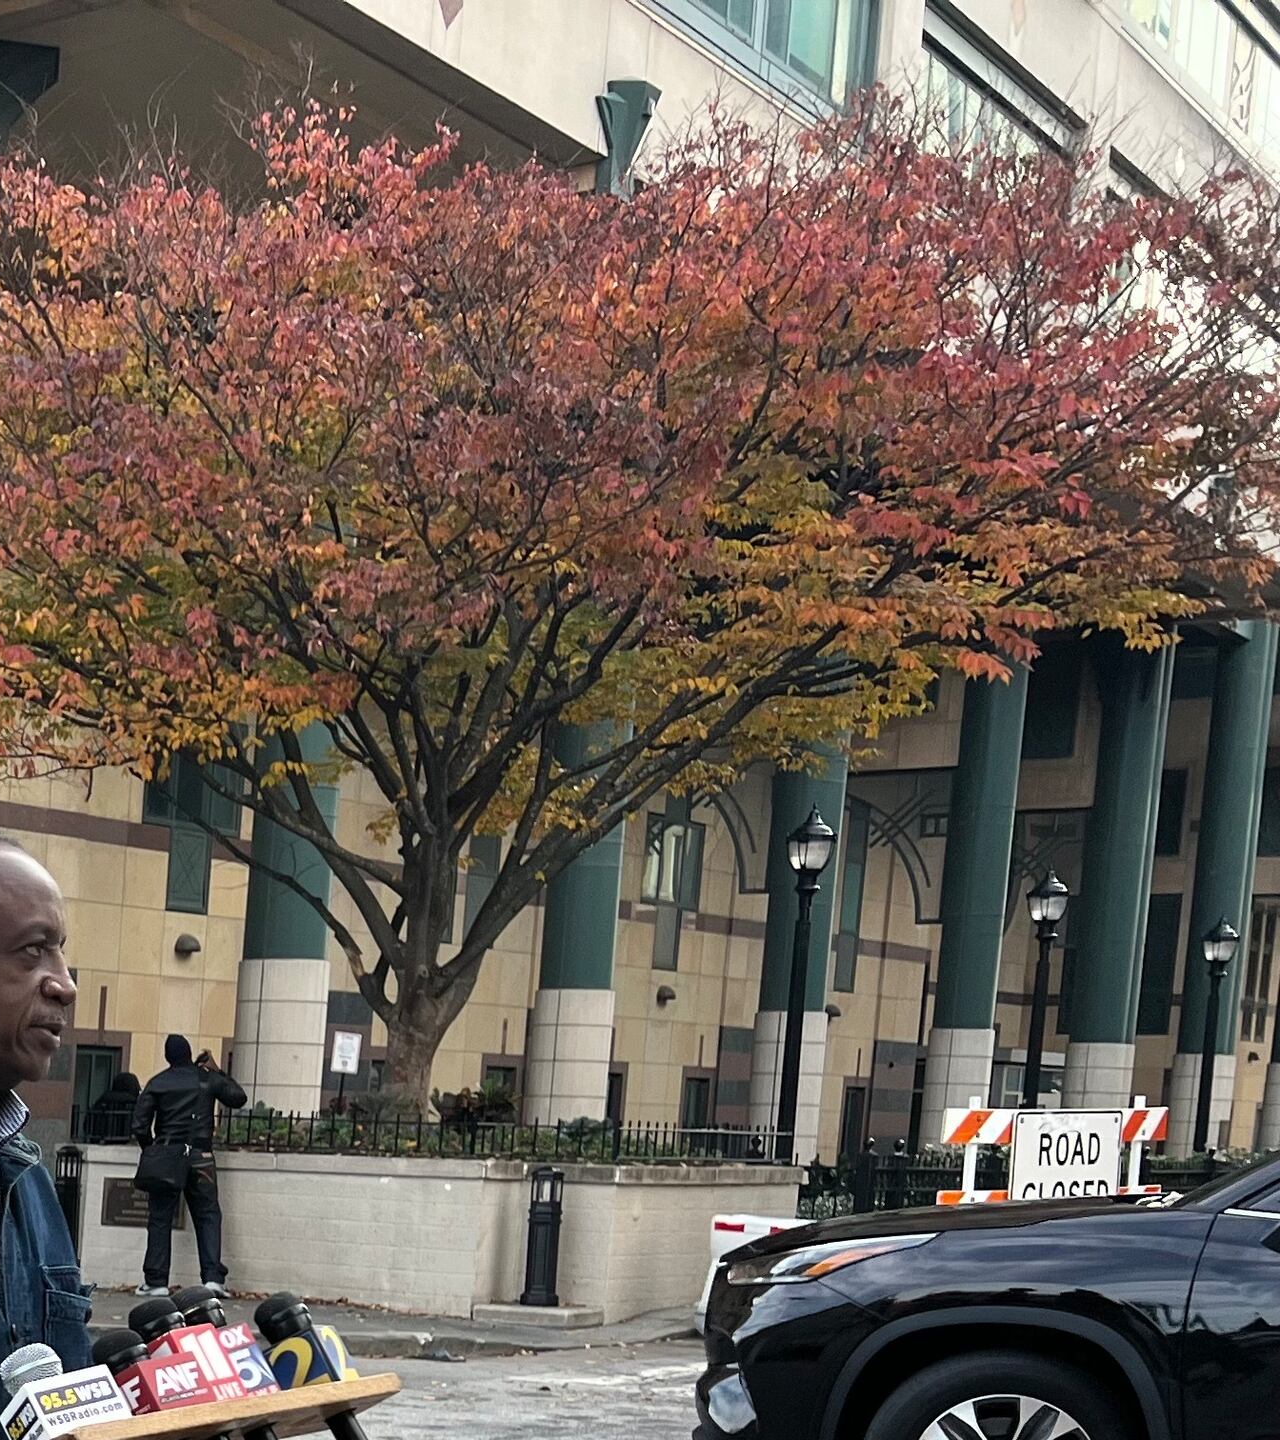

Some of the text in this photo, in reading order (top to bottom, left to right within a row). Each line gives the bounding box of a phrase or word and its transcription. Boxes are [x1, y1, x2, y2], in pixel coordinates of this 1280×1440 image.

[1038, 1132, 1101, 1166] ROAD
[219, 1325, 251, 1349] OX
[179, 1329, 234, 1382] 11
[228, 1347, 263, 1389] 5
[269, 1336, 330, 1388] 2
[155, 1360, 199, 1397] ANF
[212, 1381, 244, 1401] LIVE
[46, 1402, 124, 1427] WSBRadio.com
